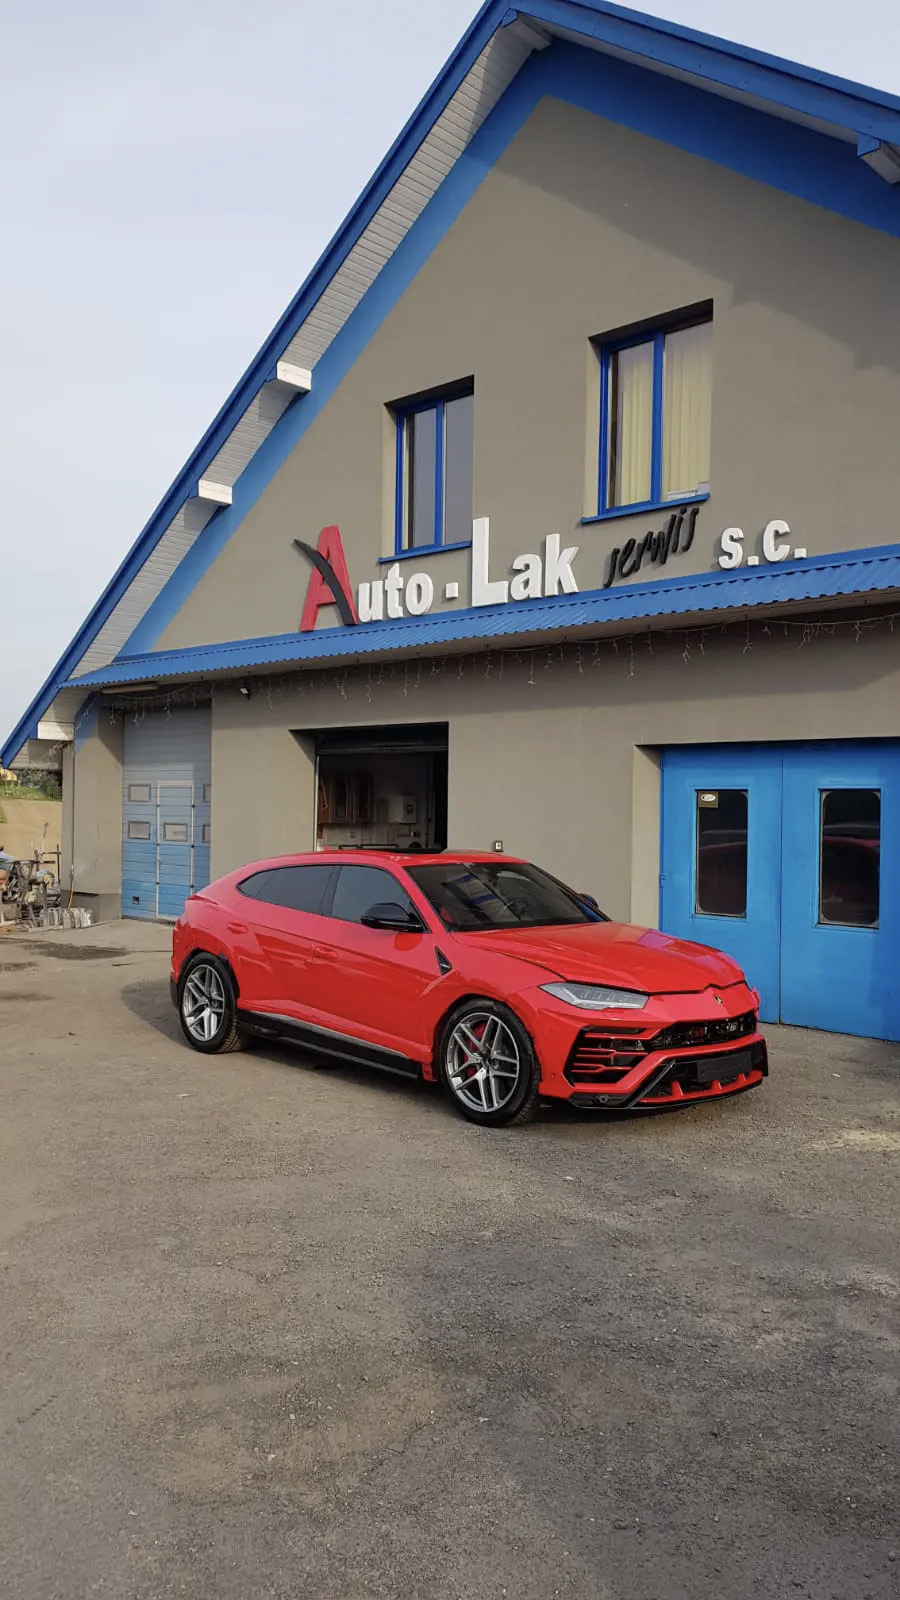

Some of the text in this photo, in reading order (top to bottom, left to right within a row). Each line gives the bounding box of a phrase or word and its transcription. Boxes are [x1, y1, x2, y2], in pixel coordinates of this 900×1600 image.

[295, 525, 434, 632] Auto
[472, 517, 580, 607] Lak
[604, 507, 699, 588] serwis
[719, 519, 807, 569] s.c.
